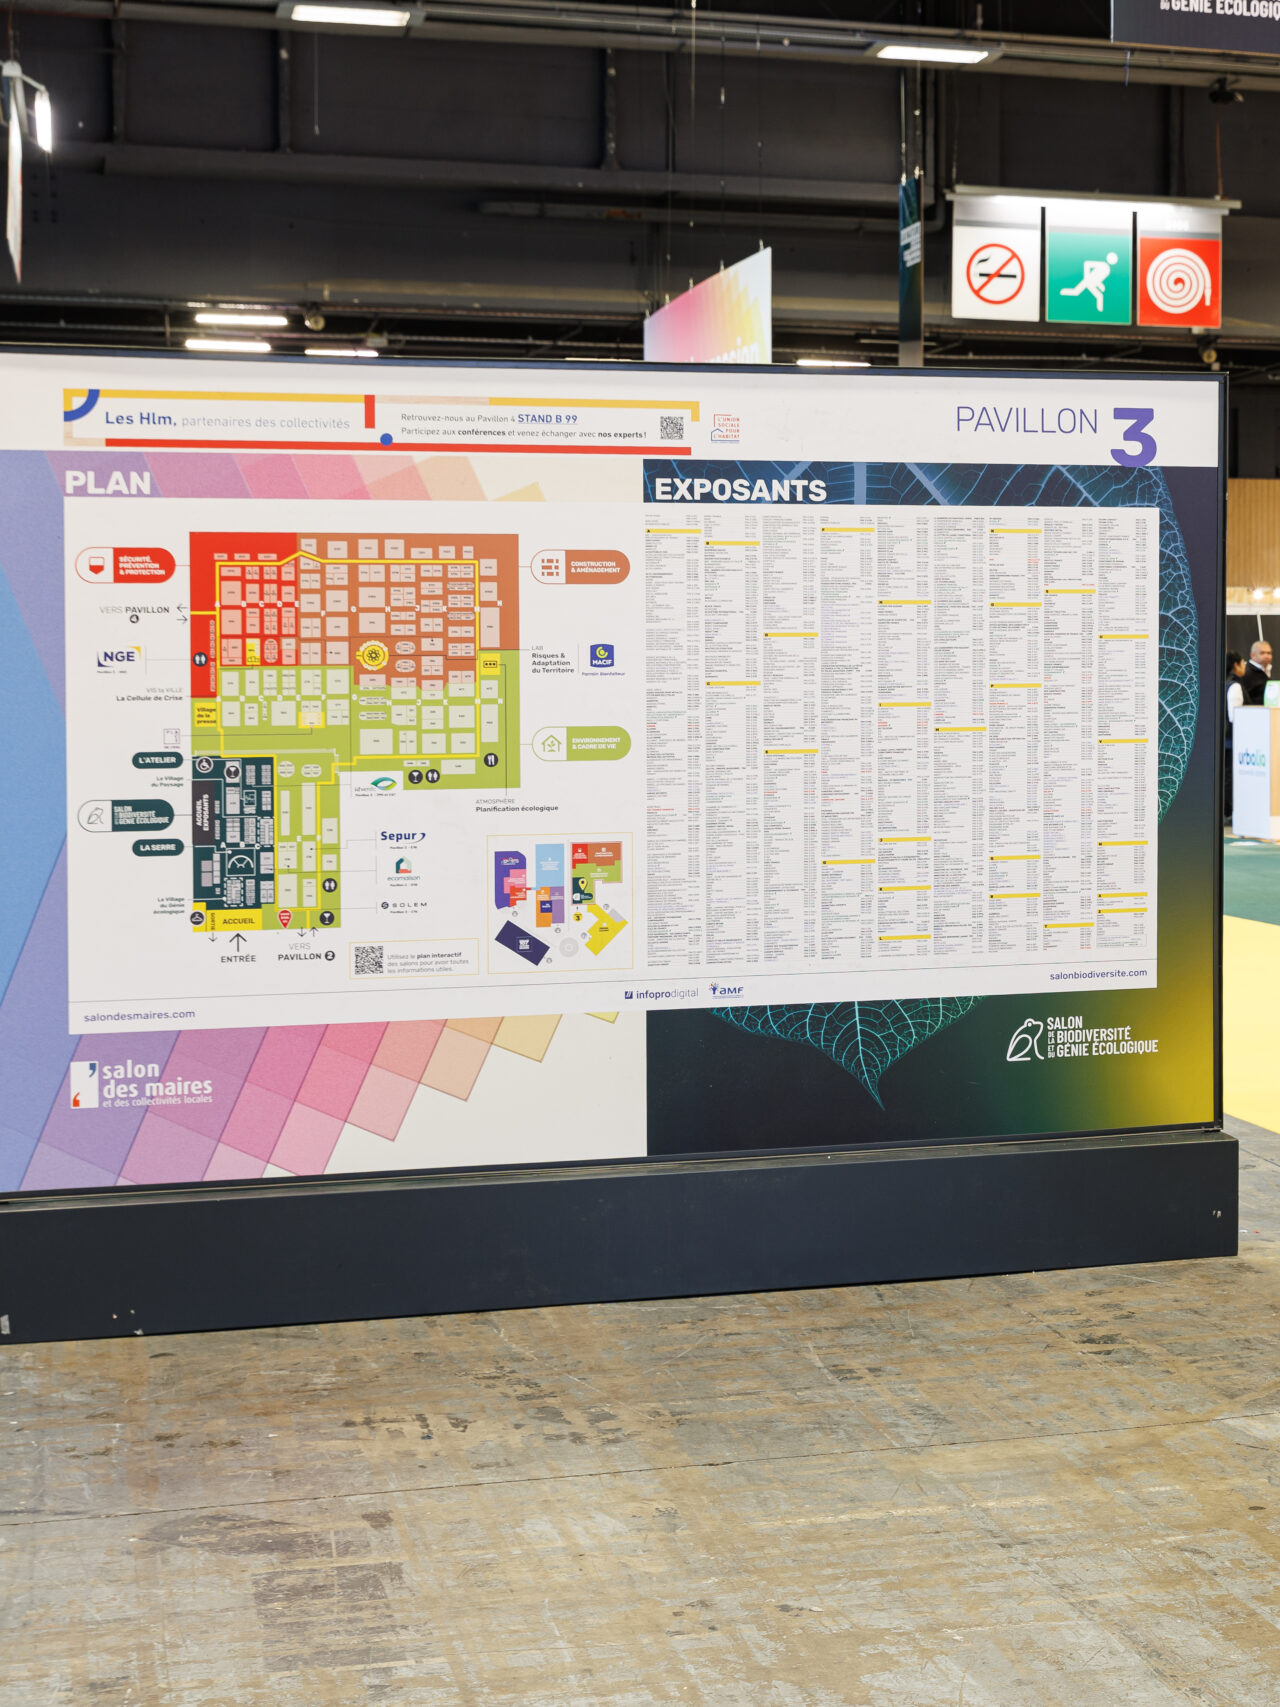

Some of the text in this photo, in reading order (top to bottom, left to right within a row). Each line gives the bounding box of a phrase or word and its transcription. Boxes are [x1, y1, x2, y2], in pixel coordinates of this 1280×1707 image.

[105, 411, 134, 425] Les
[181, 416, 251, 430] partenaires
[255, 416, 276, 428] des
[279, 416, 350, 430] collectivités
[401, 414, 463, 423] Retrouvez-nous
[478, 414, 508, 423] Pavillon
[518, 414, 552, 424] STAND
[556, 414, 562, 424] B
[401, 428, 440, 437] Participez
[458, 428, 506, 437] conférences
[542, 430, 577, 438] échanger
[956, 406, 1157, 468] PAVILLON 3
[65, 470, 151, 495] PLAN
[655, 478, 827, 502] EXPOSANTS
[104, 651, 135, 662] NGE
[381, 831, 416, 842] Sepur
[220, 954, 256, 963] ENTRÉE
[278, 952, 322, 961] PAVILLON
[1050, 970, 1148, 980] salonbiodiversite.com
[636, 988, 698, 1000] infoprodigital
[84, 1010, 196, 1022] salondesmaires.com
[1047, 1016, 1082, 1030] SALON
[1057, 1026, 1132, 1044] BIODIVERSITÉ
[1057, 1040, 1158, 1057] GÉNIE ÉCOLOGIQUE
[102, 1059, 160, 1080] salon
[103, 1077, 212, 1098] des maires
[102, 1095, 212, 1108] et des collectivités locales
